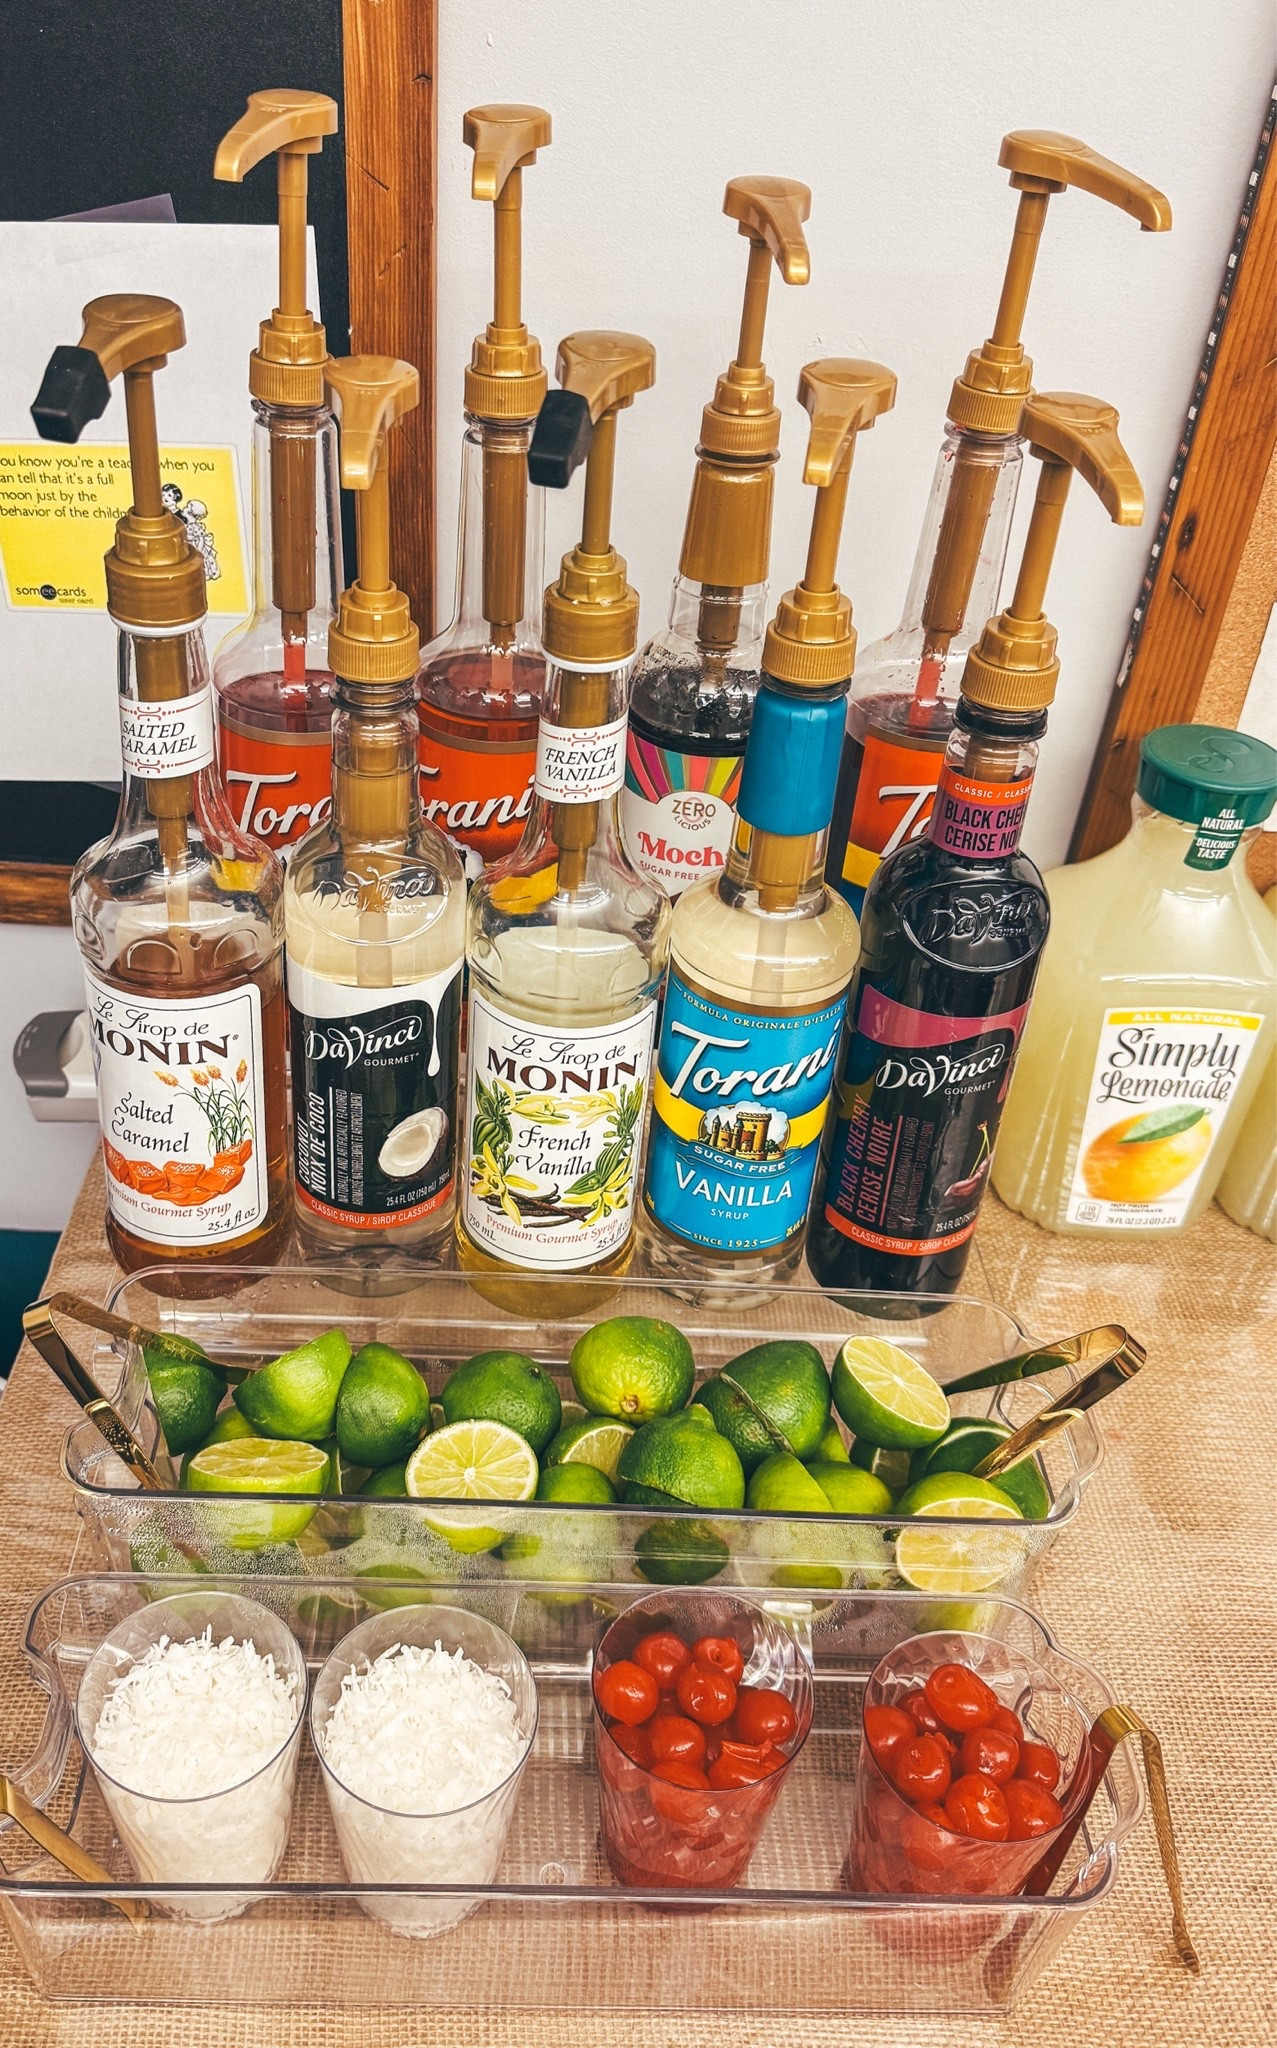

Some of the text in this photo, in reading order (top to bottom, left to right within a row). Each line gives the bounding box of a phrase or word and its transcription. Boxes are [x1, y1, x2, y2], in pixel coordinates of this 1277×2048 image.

[0, 457, 16, 467] ou
[19, 454, 52, 467] know
[56, 455, 94, 470] you're
[97, 459, 105, 468] a
[192, 461, 215, 474] you
[0, 471, 114, 485] an tell that it's a full
[36, 489, 57, 504] just
[60, 490, 73, 504] by
[78, 490, 97, 502] the
[0, 505, 51, 517] behavior
[55, 506, 66, 517] of
[70, 507, 89, 519] the
[16, 584, 86, 601] someecards
[123, 721, 185, 739] SALTED
[121, 735, 198, 756] CARAMEL
[545, 743, 618, 765] FRENCH
[545, 760, 616, 782] VANILLA
[954, 782, 993, 799] CLASSIC
[671, 799, 716, 819] ZERO
[944, 800, 994, 830] BLACK
[1218, 808, 1236, 819] ALL
[673, 815, 712, 831] LICIOUS
[1201, 816, 1246, 831] NATURAL
[637, 831, 725, 867] Moch
[944, 825, 998, 852] CERISE
[1196, 837, 1237, 849] DELICIOUS
[1197, 847, 1228, 860] TASTE
[639, 860, 700, 881] SUGAR FREE
[93, 996, 210, 1043] Le Sirop de
[682, 991, 842, 1030] FORMULA ORIGINALE D'ITALIA
[1132, 1012, 1242, 1026] ALL NATURAL
[305, 1014, 423, 1070] DaVinci
[502, 1034, 626, 1070] Le Sirop de
[1108, 1028, 1240, 1078] Simply
[671, 1018, 842, 1100] Torani
[875, 1043, 1006, 1099] DaVinci
[1096, 1070, 1231, 1104] Lemonade
[114, 1091, 174, 1125] Salted
[335, 1088, 348, 1120] FLAVORED
[111, 1116, 190, 1154] Caramel
[308, 1091, 327, 1196] NOIX DE COCO
[518, 1124, 591, 1151] French
[297, 1112, 310, 1185] COCONUT
[693, 1145, 786, 1175] SUGAR FREE
[837, 1093, 872, 1213] BLACK CHERRY
[337, 1156, 349, 1171] AND
[515, 1153, 593, 1177] Vanilla
[857, 1115, 893, 1224] CERISE NOIRE
[675, 1160, 793, 1207] VANILLA
[140, 1201, 193, 1218] Gourmet
[196, 1201, 232, 1221] Syrup
[311, 1199, 338, 1219] CLASSIC
[340, 1212, 365, 1225] SYRUP
[372, 1214, 397, 1225] SIROP
[398, 1198, 437, 1222] CLASSIQUE
[386, 1195, 399, 1207] 25.4
[400, 1193, 407, 1204] FL
[407, 1191, 416, 1203] OZ
[207, 1206, 256, 1231] 25.4 fl oz
[710, 1208, 750, 1220] SYRUP
[469, 1213, 497, 1241] 750 mL
[486, 1213, 533, 1241] Premium
[536, 1230, 588, 1244] Gourmet
[851, 1226, 883, 1246] CLASSIC
[885, 1239, 912, 1250] SYRUP
[919, 1241, 942, 1252] SIROP
[596, 1233, 615, 1249] 25.4
[693, 1232, 759, 1248] SINCE 1925
